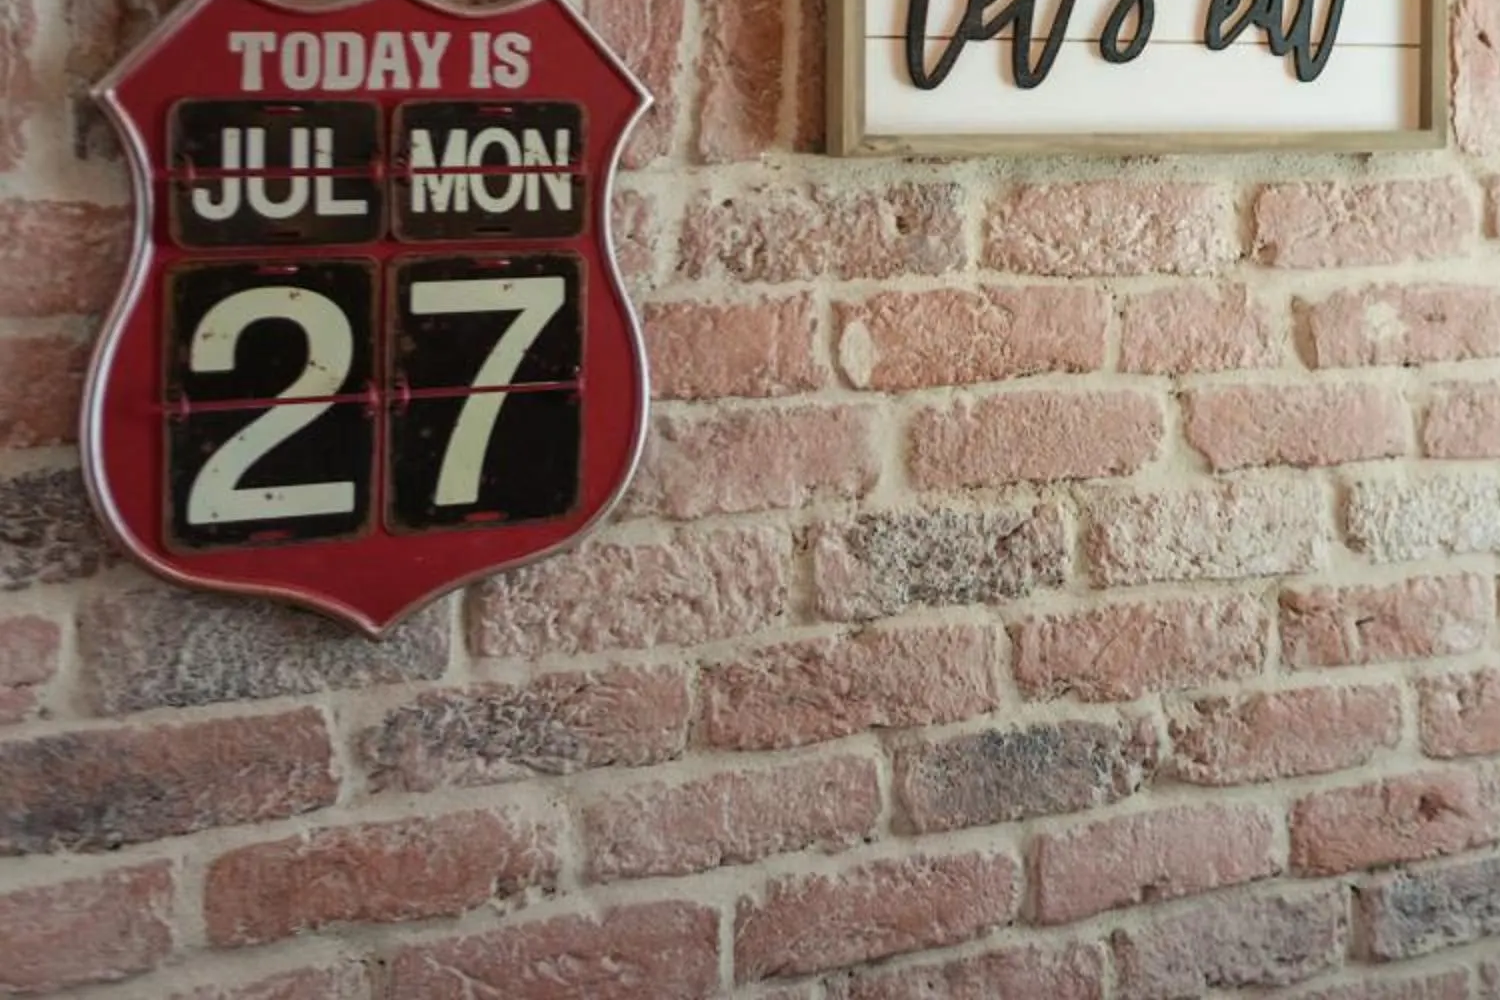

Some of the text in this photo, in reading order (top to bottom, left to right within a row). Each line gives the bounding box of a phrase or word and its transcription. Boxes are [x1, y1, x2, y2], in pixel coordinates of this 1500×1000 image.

[228, 31, 532, 92] TODAY IS
[192, 126, 573, 221] JUL MON
